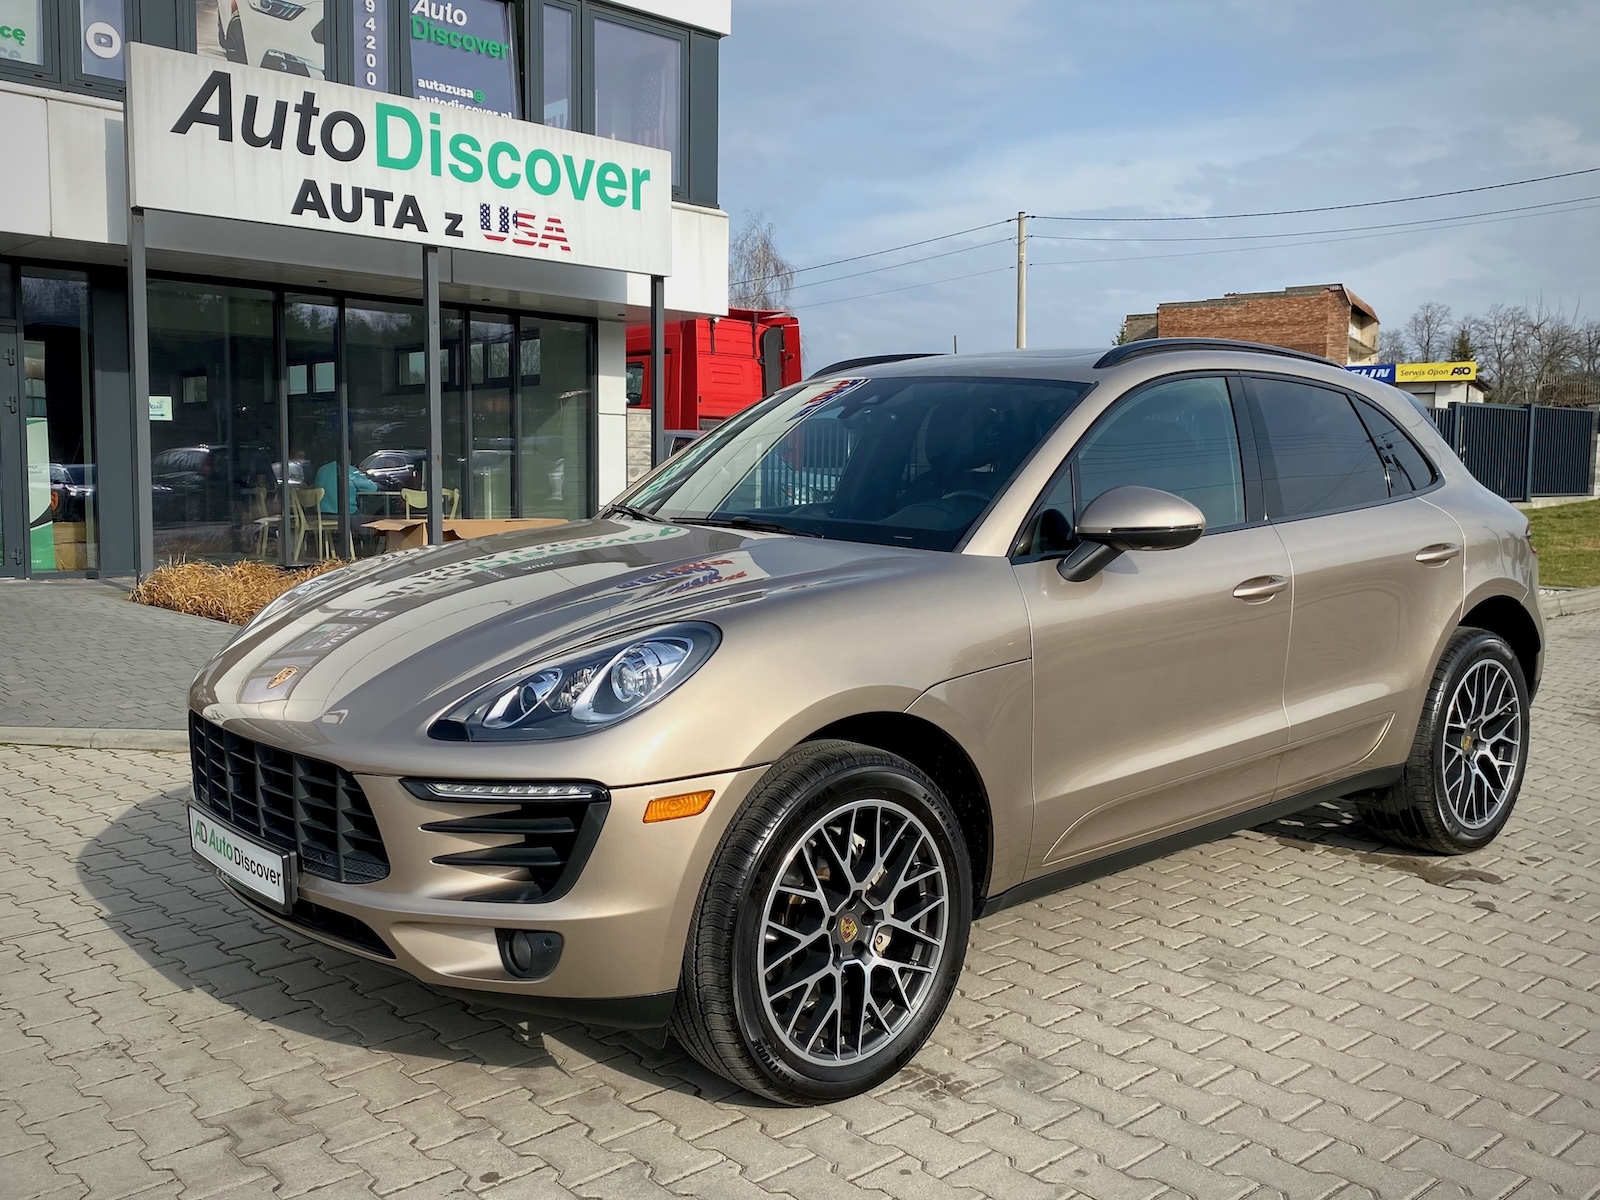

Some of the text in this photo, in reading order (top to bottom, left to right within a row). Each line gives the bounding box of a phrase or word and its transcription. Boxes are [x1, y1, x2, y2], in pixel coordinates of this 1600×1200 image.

[411, 0, 468, 26] Auto
[411, 16, 509, 59] Discover
[417, 79, 485, 103] autazusa@
[170, 70, 651, 211] AutoDiscover
[290, 179, 572, 252] AUTA z USA
[1400, 368, 1425, 377] Serwis
[1427, 368, 1449, 377] Opon
[208, 828, 282, 887] AutoDiscover
